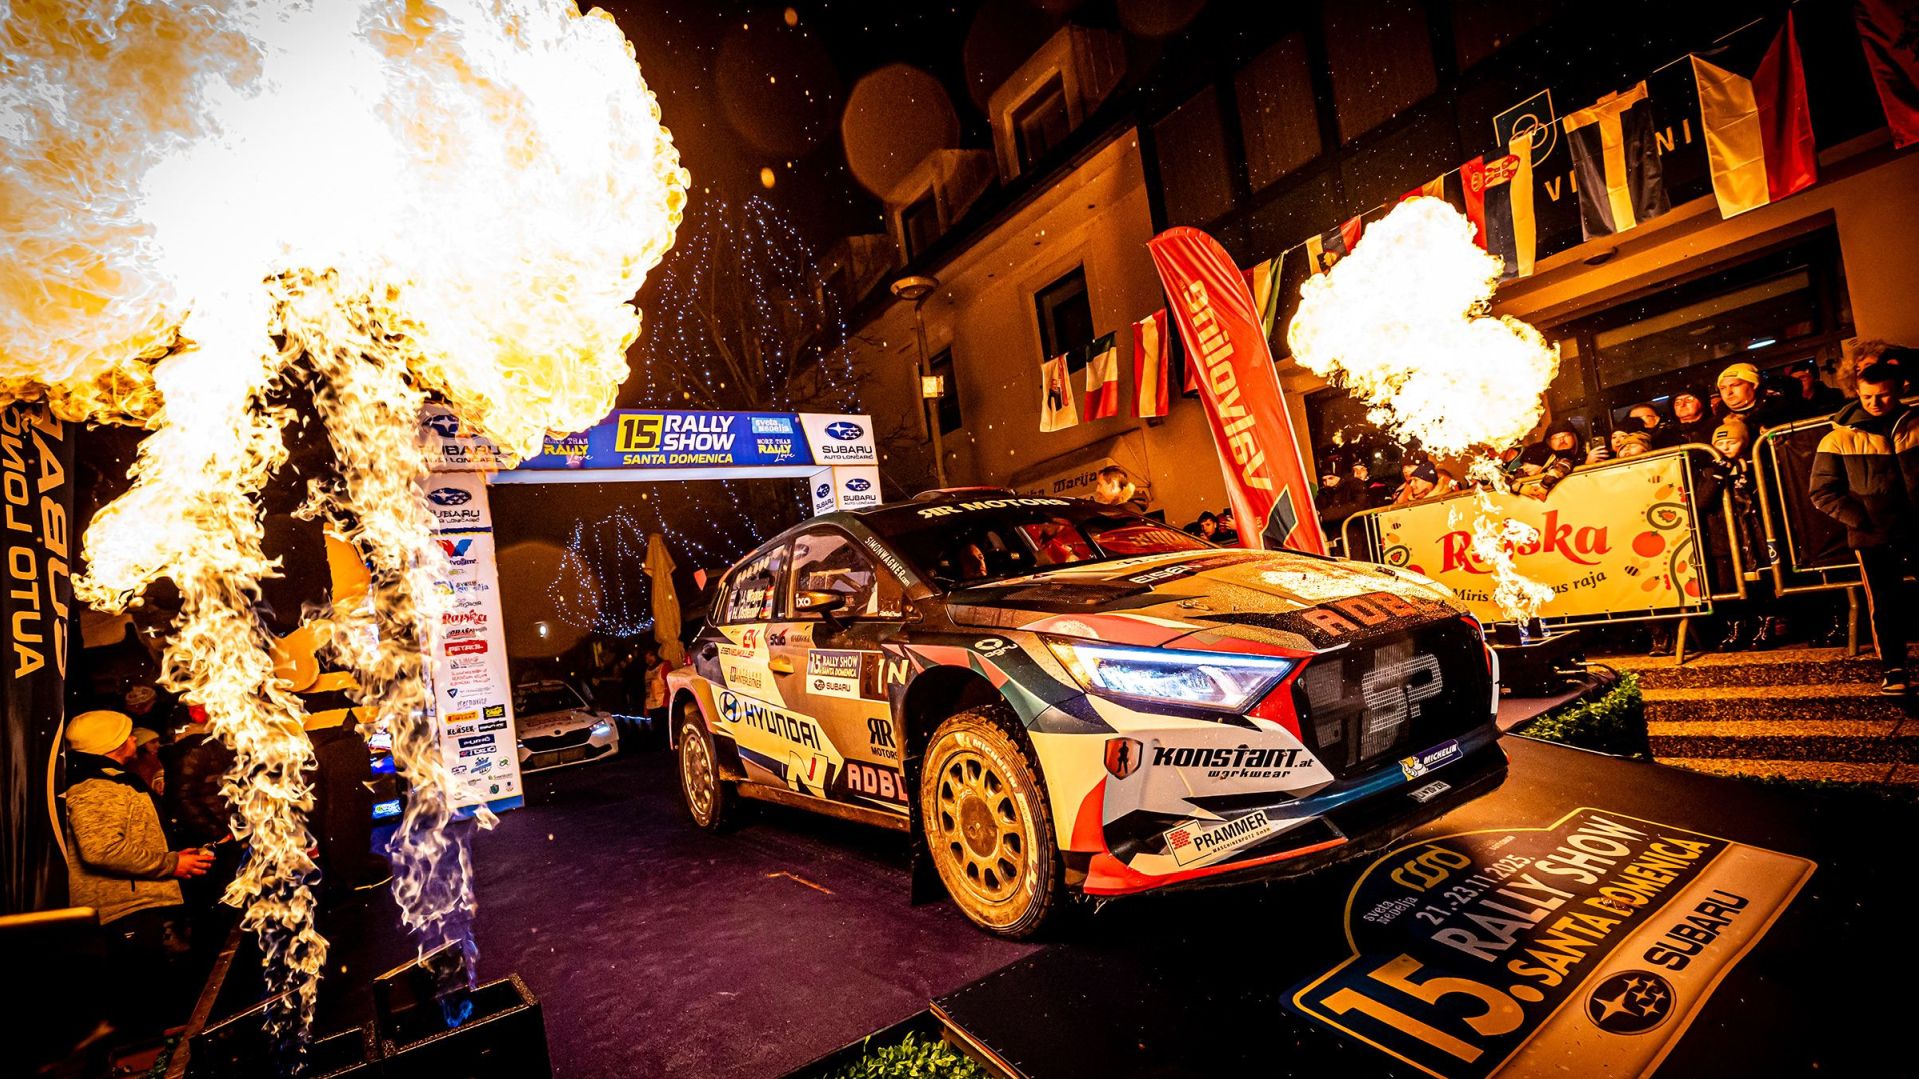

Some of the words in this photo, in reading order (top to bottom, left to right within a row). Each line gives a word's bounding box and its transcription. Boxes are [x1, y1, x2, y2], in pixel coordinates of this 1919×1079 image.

[665, 415, 735, 433] RALLY
[543, 444, 589, 456] RALLY
[662, 433, 736, 451] SHOW
[758, 445, 791, 454] RALLY
[822, 445, 873, 454] SUBARU
[623, 454, 666, 465] SANTA
[669, 453, 733, 465] DOMENICA
[959, 498, 1071, 512] MOTORS
[1572, 570, 1607, 589] raja
[795, 593, 811, 609] ixo
[823, 656, 839, 667] RALLY
[840, 655, 858, 668] SHOW
[826, 682, 851, 692] SUBARU
[744, 701, 821, 751] HYUNDAI
[871, 746, 899, 760] MOTORS
[1423, 744, 1458, 764] MICHELIN
[1193, 812, 1268, 852] PRAMMER
[1431, 871, 1575, 963] RALLY
[1539, 814, 1649, 885] SHOW
[1507, 900, 1613, 988] SANTA
[1596, 836, 1711, 916] DOMENICA
[1643, 889, 1749, 972] SUBARU
